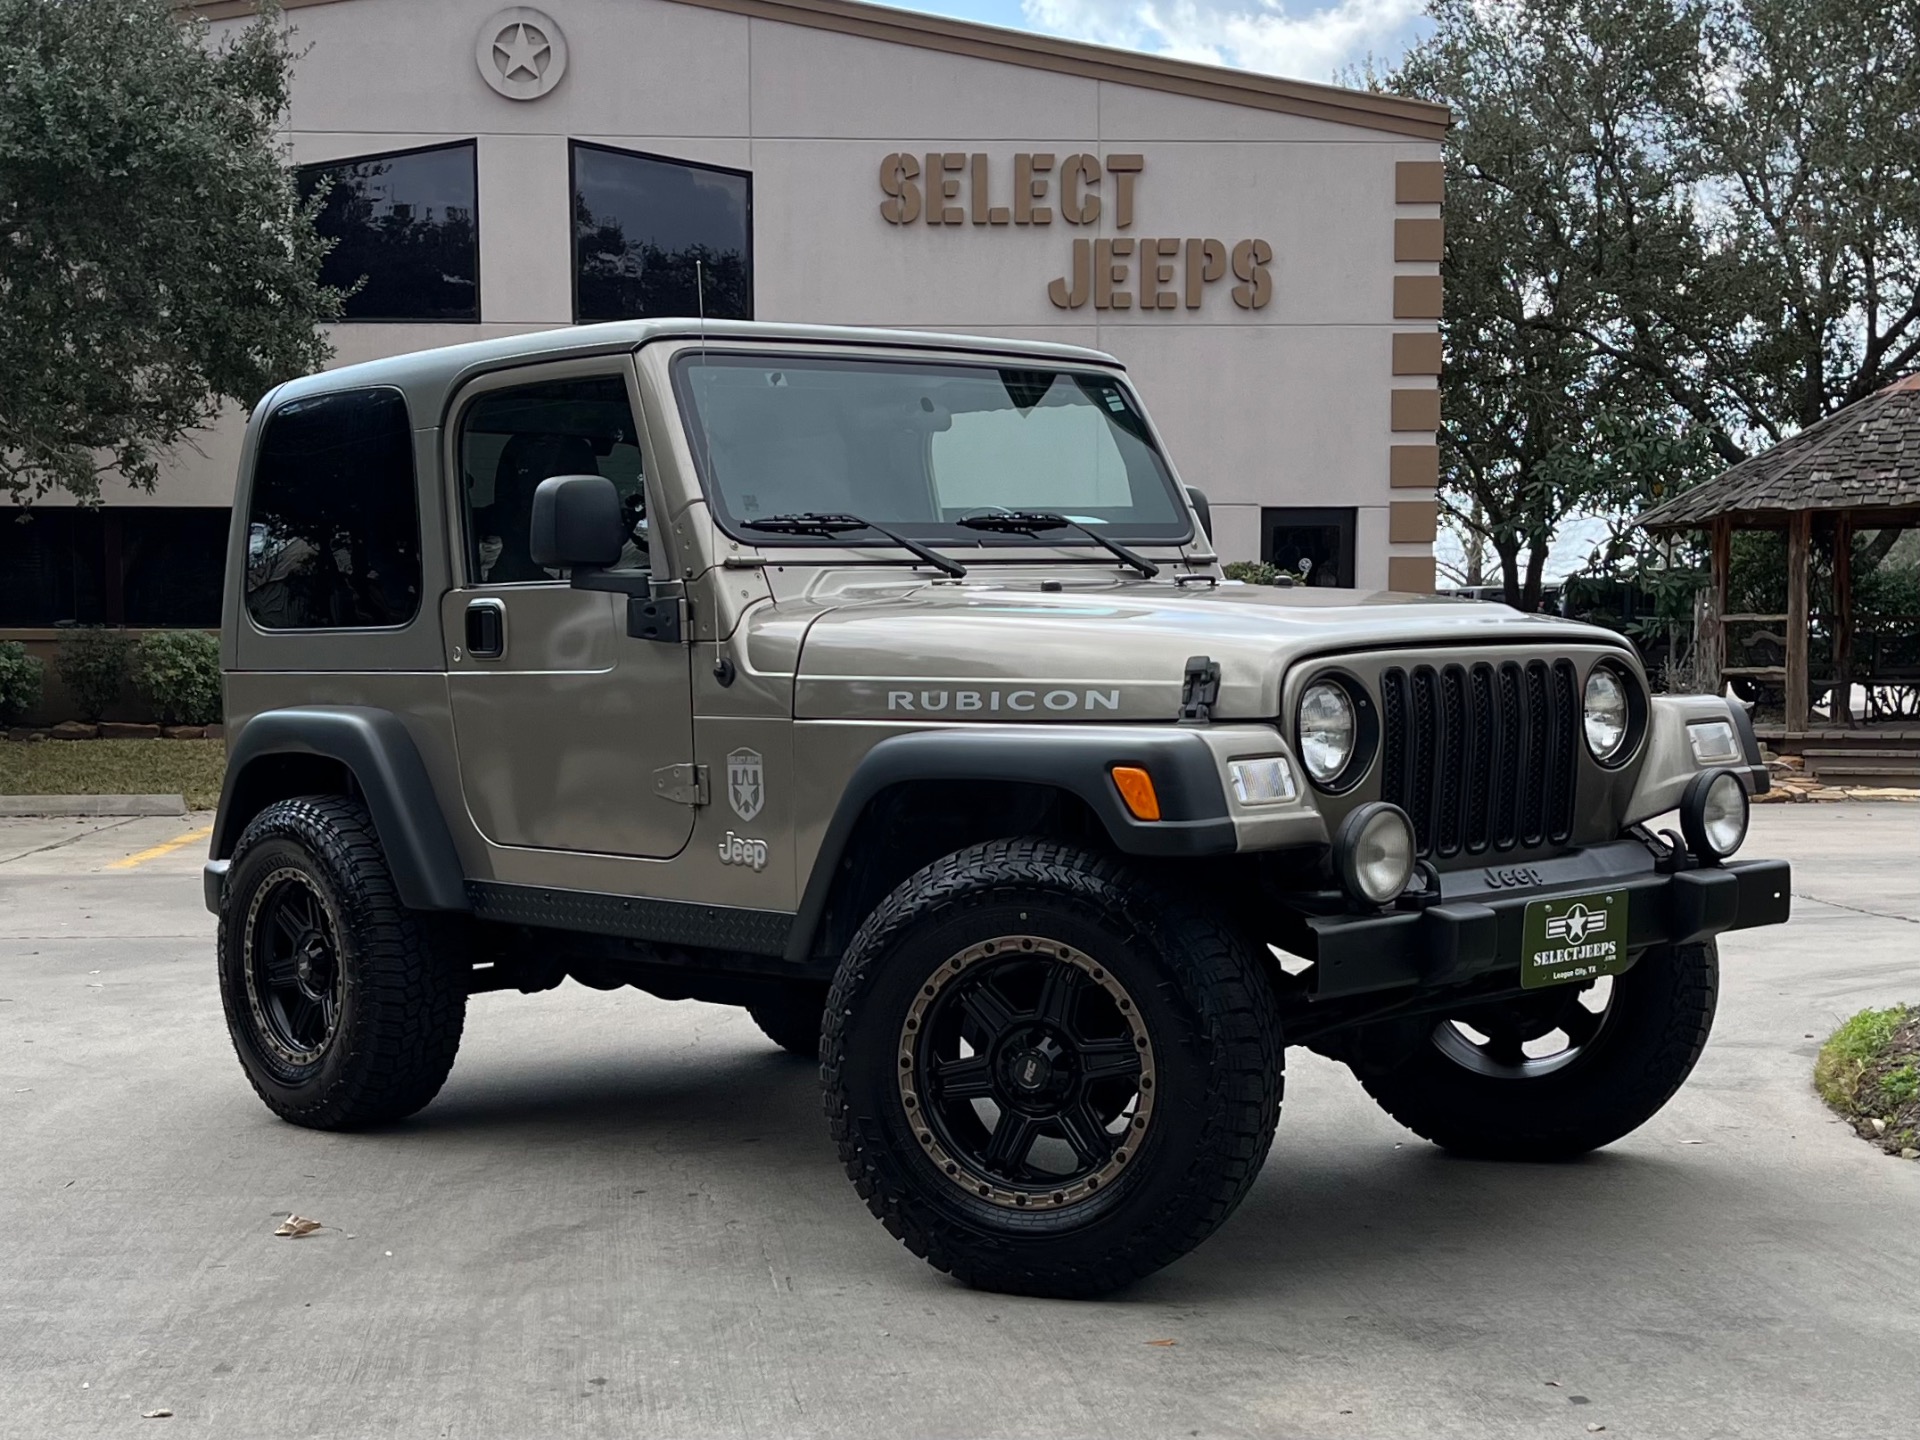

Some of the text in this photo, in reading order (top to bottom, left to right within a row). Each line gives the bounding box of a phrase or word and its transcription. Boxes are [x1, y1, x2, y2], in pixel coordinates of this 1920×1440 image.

[879, 152, 1145, 229] SELECT
[1047, 238, 1273, 309] JEEPS
[887, 690, 1120, 711] RUBICON
[718, 831, 768, 872] Jeep
[1484, 868, 1542, 888] Jeep
[1533, 941, 1616, 966] SELECTJEEPS
[1553, 970, 1574, 980] League
[1588, 965, 1596, 973] TX
[1024, 1060, 1037, 1083] RC
